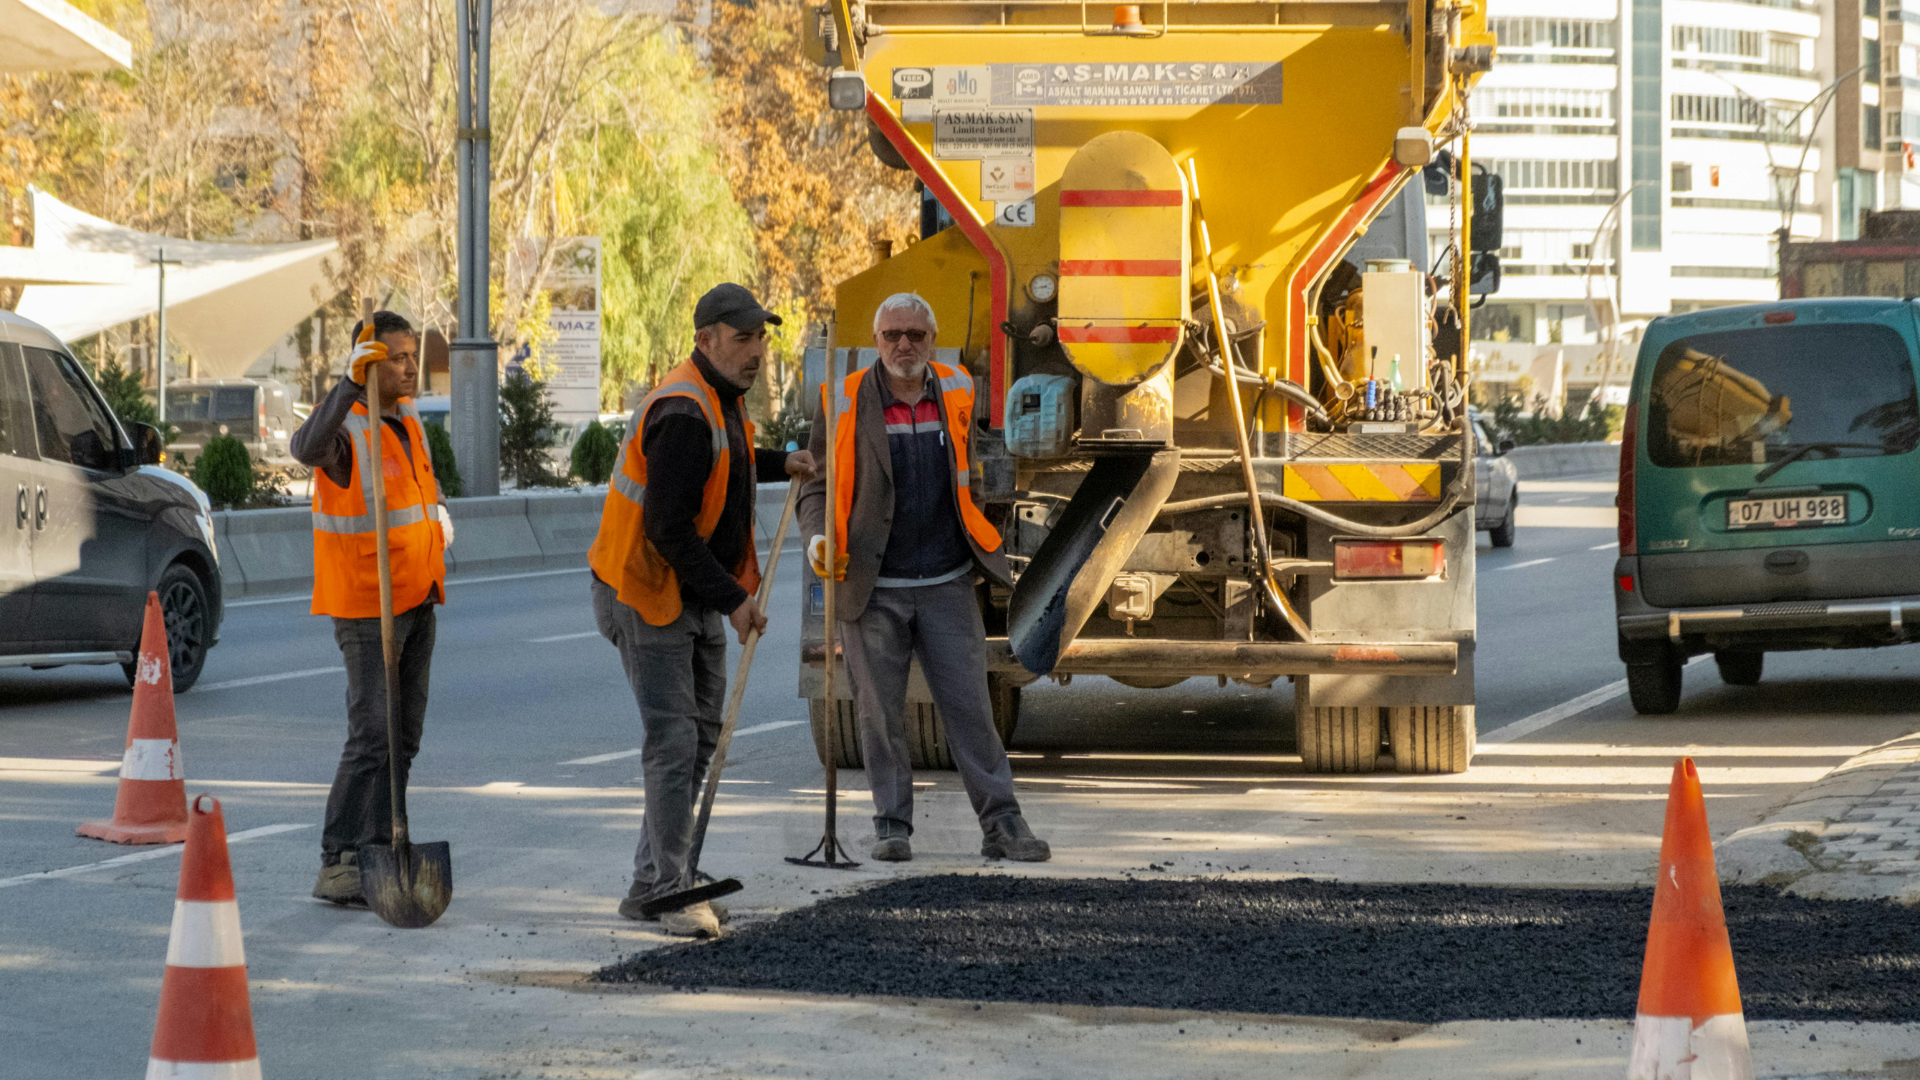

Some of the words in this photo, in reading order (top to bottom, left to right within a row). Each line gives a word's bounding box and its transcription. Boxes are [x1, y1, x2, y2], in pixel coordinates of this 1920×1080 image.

[1048, 86, 1081, 97] ASFALT
[1084, 84, 1121, 96] MAKİNA
[1162, 86, 1173, 95] ve
[1175, 83, 1214, 96] TİCARET
[1060, 96, 1210, 105] www.asmaksan.com
[944, 112, 1024, 125] AS.MAK.SAN
[953, 126, 985, 134] Limited
[987, 126, 1016, 135] Şirketi
[1003, 204, 1028, 223] CE
[1741, 502, 1763, 521] 07
[1772, 500, 1800, 520] UH
[1806, 498, 1842, 518] 988
